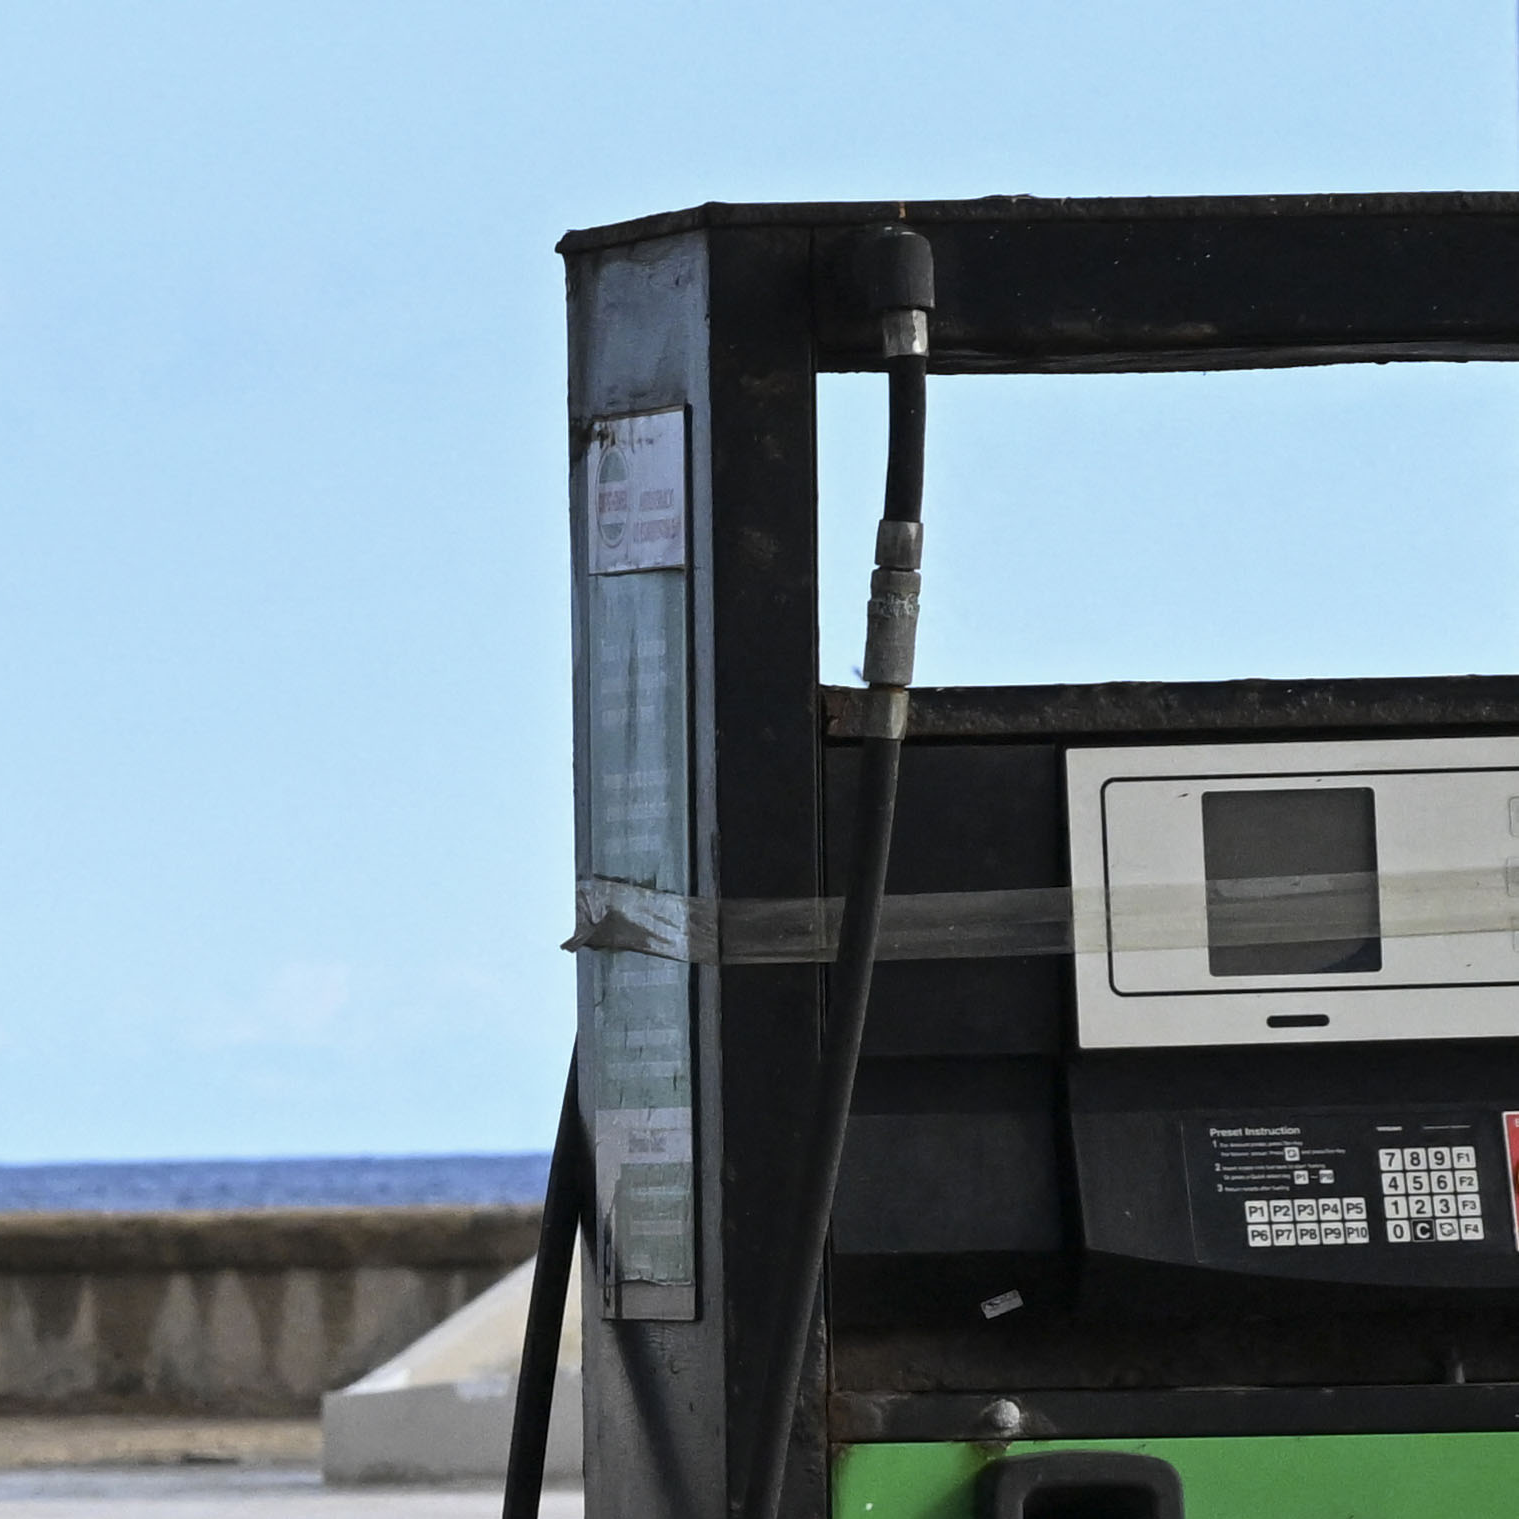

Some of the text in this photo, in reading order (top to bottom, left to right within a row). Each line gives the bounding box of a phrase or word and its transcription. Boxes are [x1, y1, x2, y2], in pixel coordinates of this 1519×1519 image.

[1210, 1125, 1300, 1137] Preset Instruction
[1385, 1151, 1470, 1168] 7 8 9 F1
[1388, 1175, 1473, 1191] 4 5 6 F2
[1249, 1203, 1363, 1217] P1 P2 P3 P4 P5
[1392, 1199, 1477, 1215] 1 2 3 F3
[1251, 1227, 1367, 1241] P6 P7 P8 P9 P10
[1393, 1222, 1479, 1238] 0 C F4
